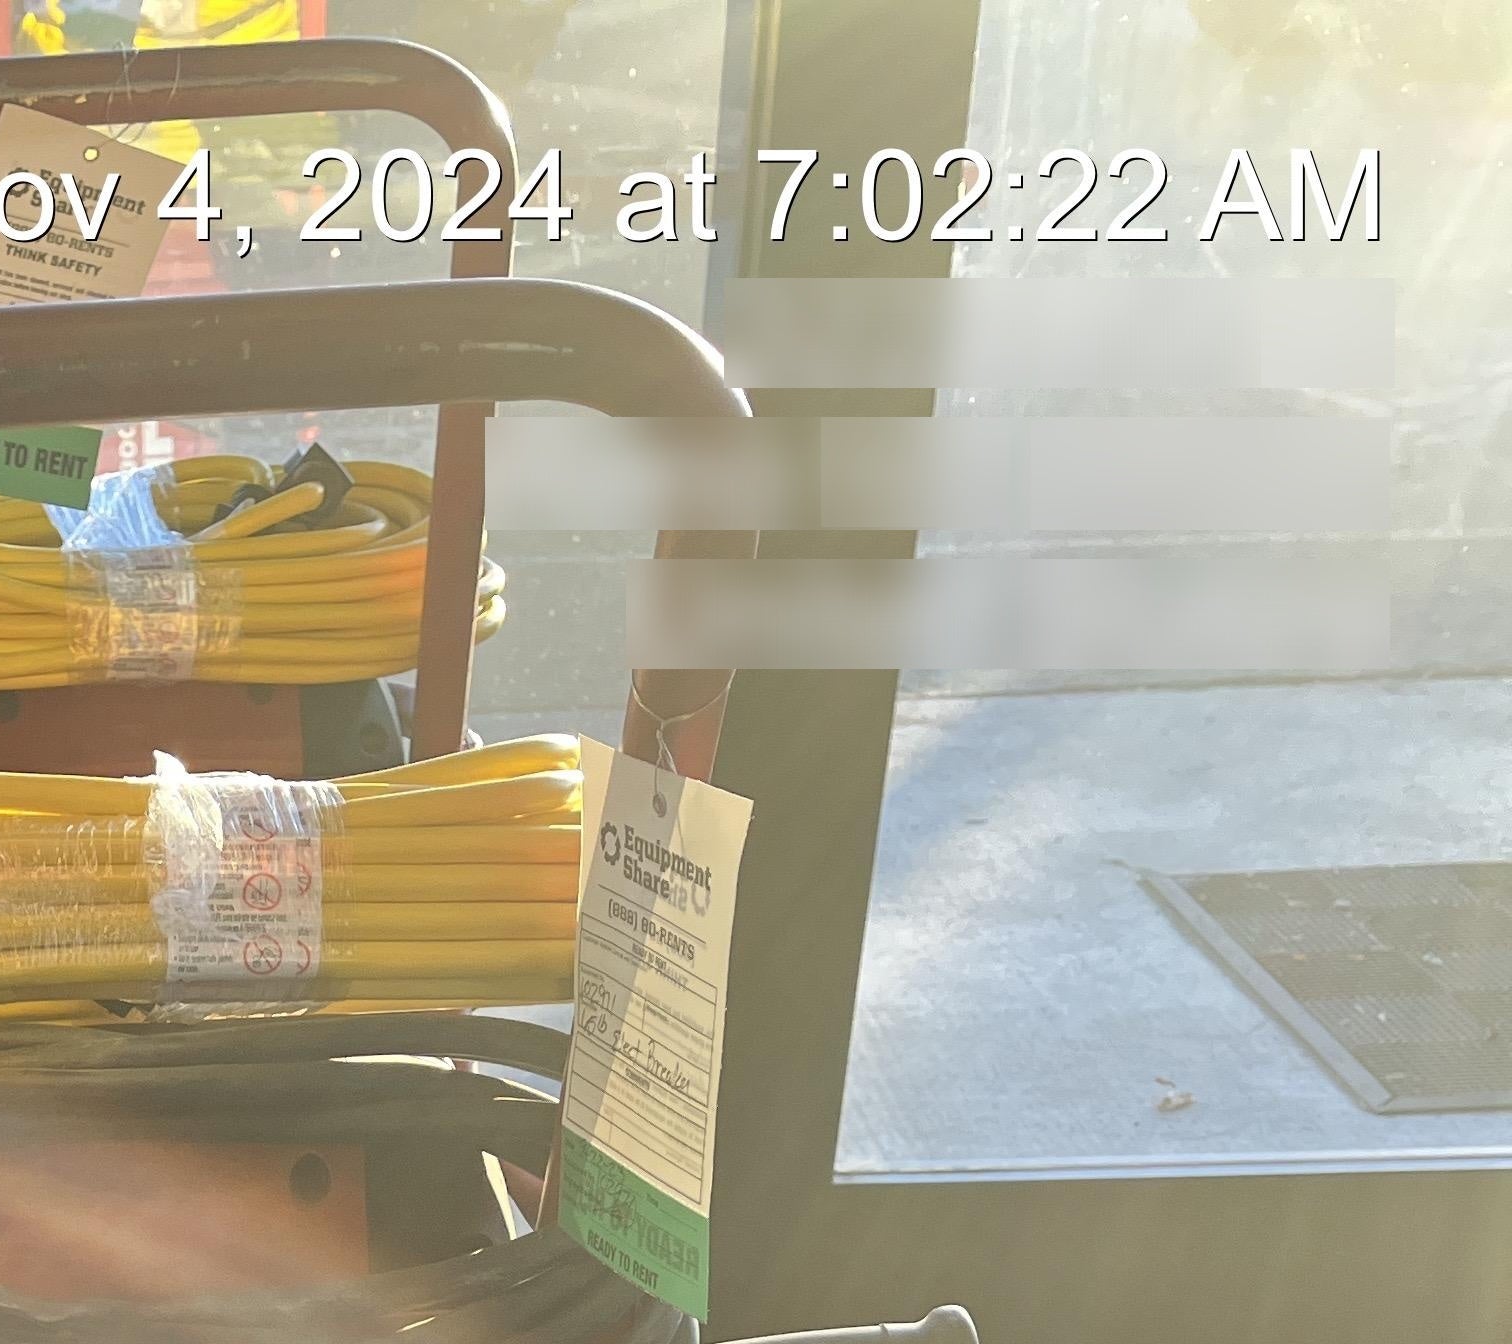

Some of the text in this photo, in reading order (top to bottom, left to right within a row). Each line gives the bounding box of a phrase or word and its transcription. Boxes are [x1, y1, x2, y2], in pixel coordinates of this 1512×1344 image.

[5, 243, 103, 277] THINK SAFETY
[4, 438, 29, 470] TO
[34, 446, 89, 480] RENT
[623, 823, 712, 892] Equipment
[623, 854, 671, 899] Share
[587, 1229, 660, 1290] READY TO RENT
